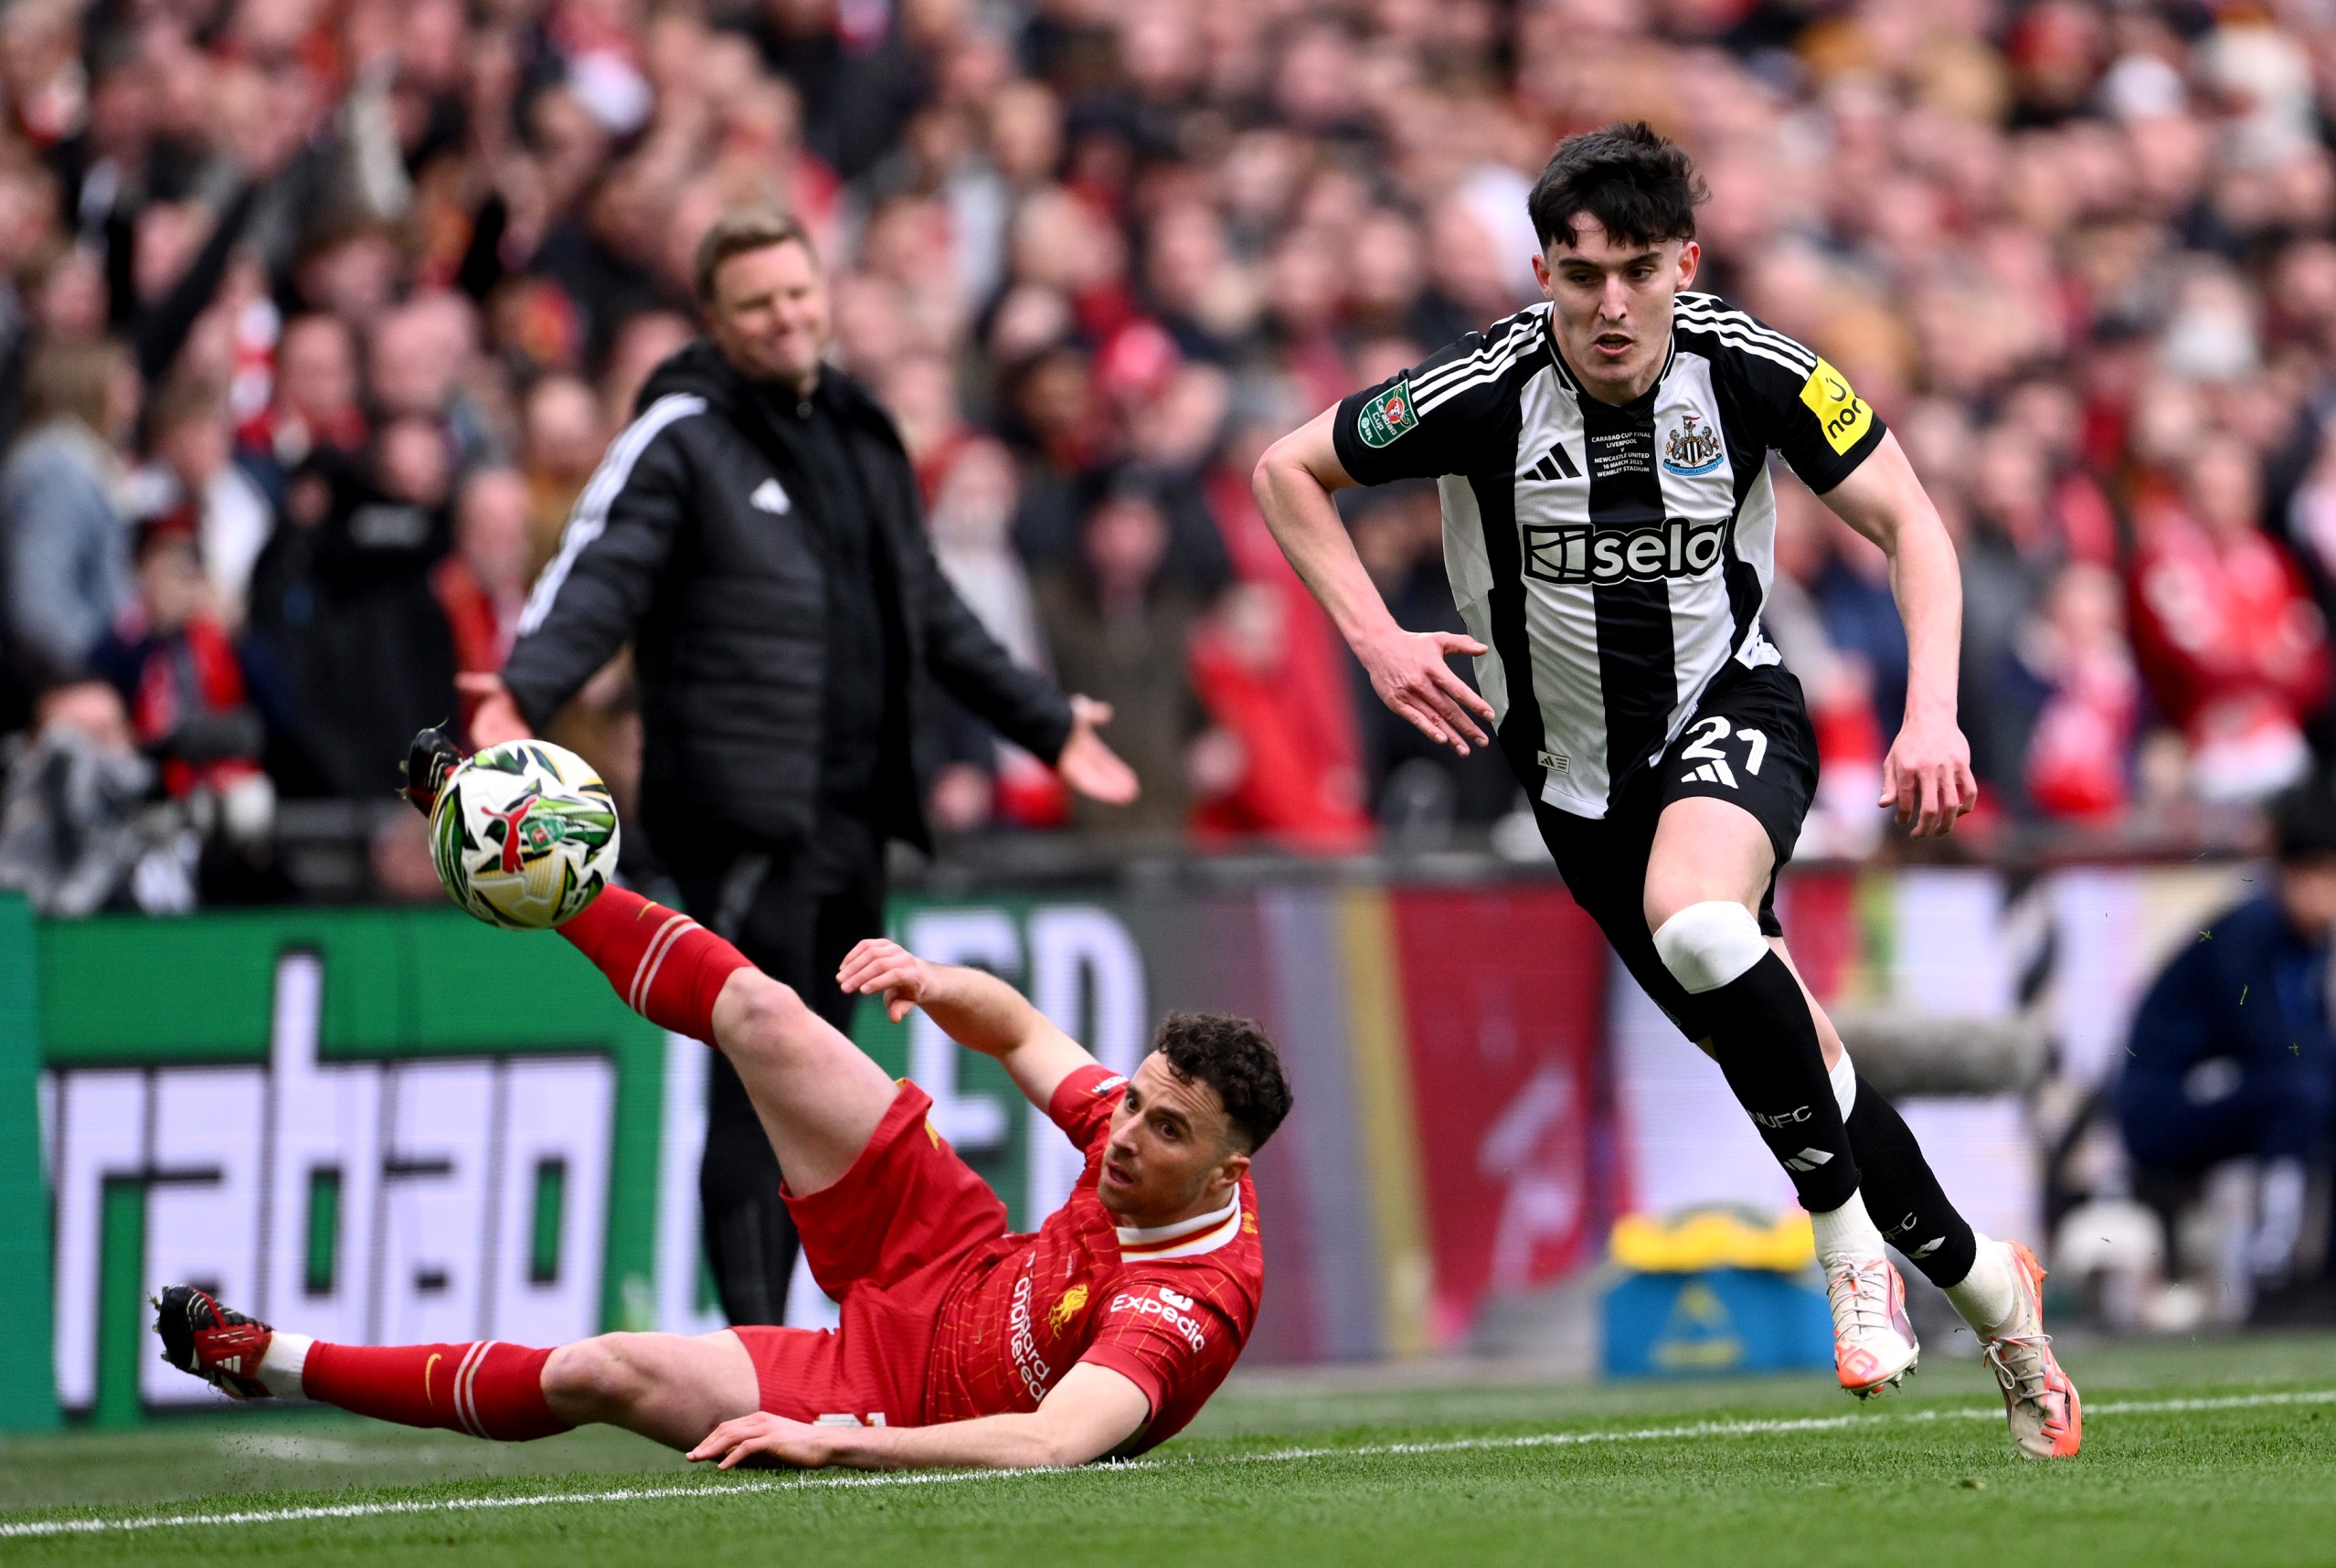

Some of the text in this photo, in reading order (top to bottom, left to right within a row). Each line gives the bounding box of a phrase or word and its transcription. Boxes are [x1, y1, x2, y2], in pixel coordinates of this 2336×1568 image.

[1372, 412, 1385, 430] Cup
[1376, 398, 1397, 436] Carabao
[1591, 434, 1620, 442] CARABAO
[1606, 439, 1637, 448] LIVERPOOL
[1594, 452, 1627, 463] NEWCASTLE
[1609, 460, 1629, 469] MARCH
[1597, 467, 1622, 477] WEMBLEY
[1592, 524, 1724, 577] sela
[1680, 715, 1768, 776] 21
[38, 948, 612, 1409] rabao
[1110, 1294, 1205, 1352] Expedia
[1010, 1276, 1047, 1403] chartered
